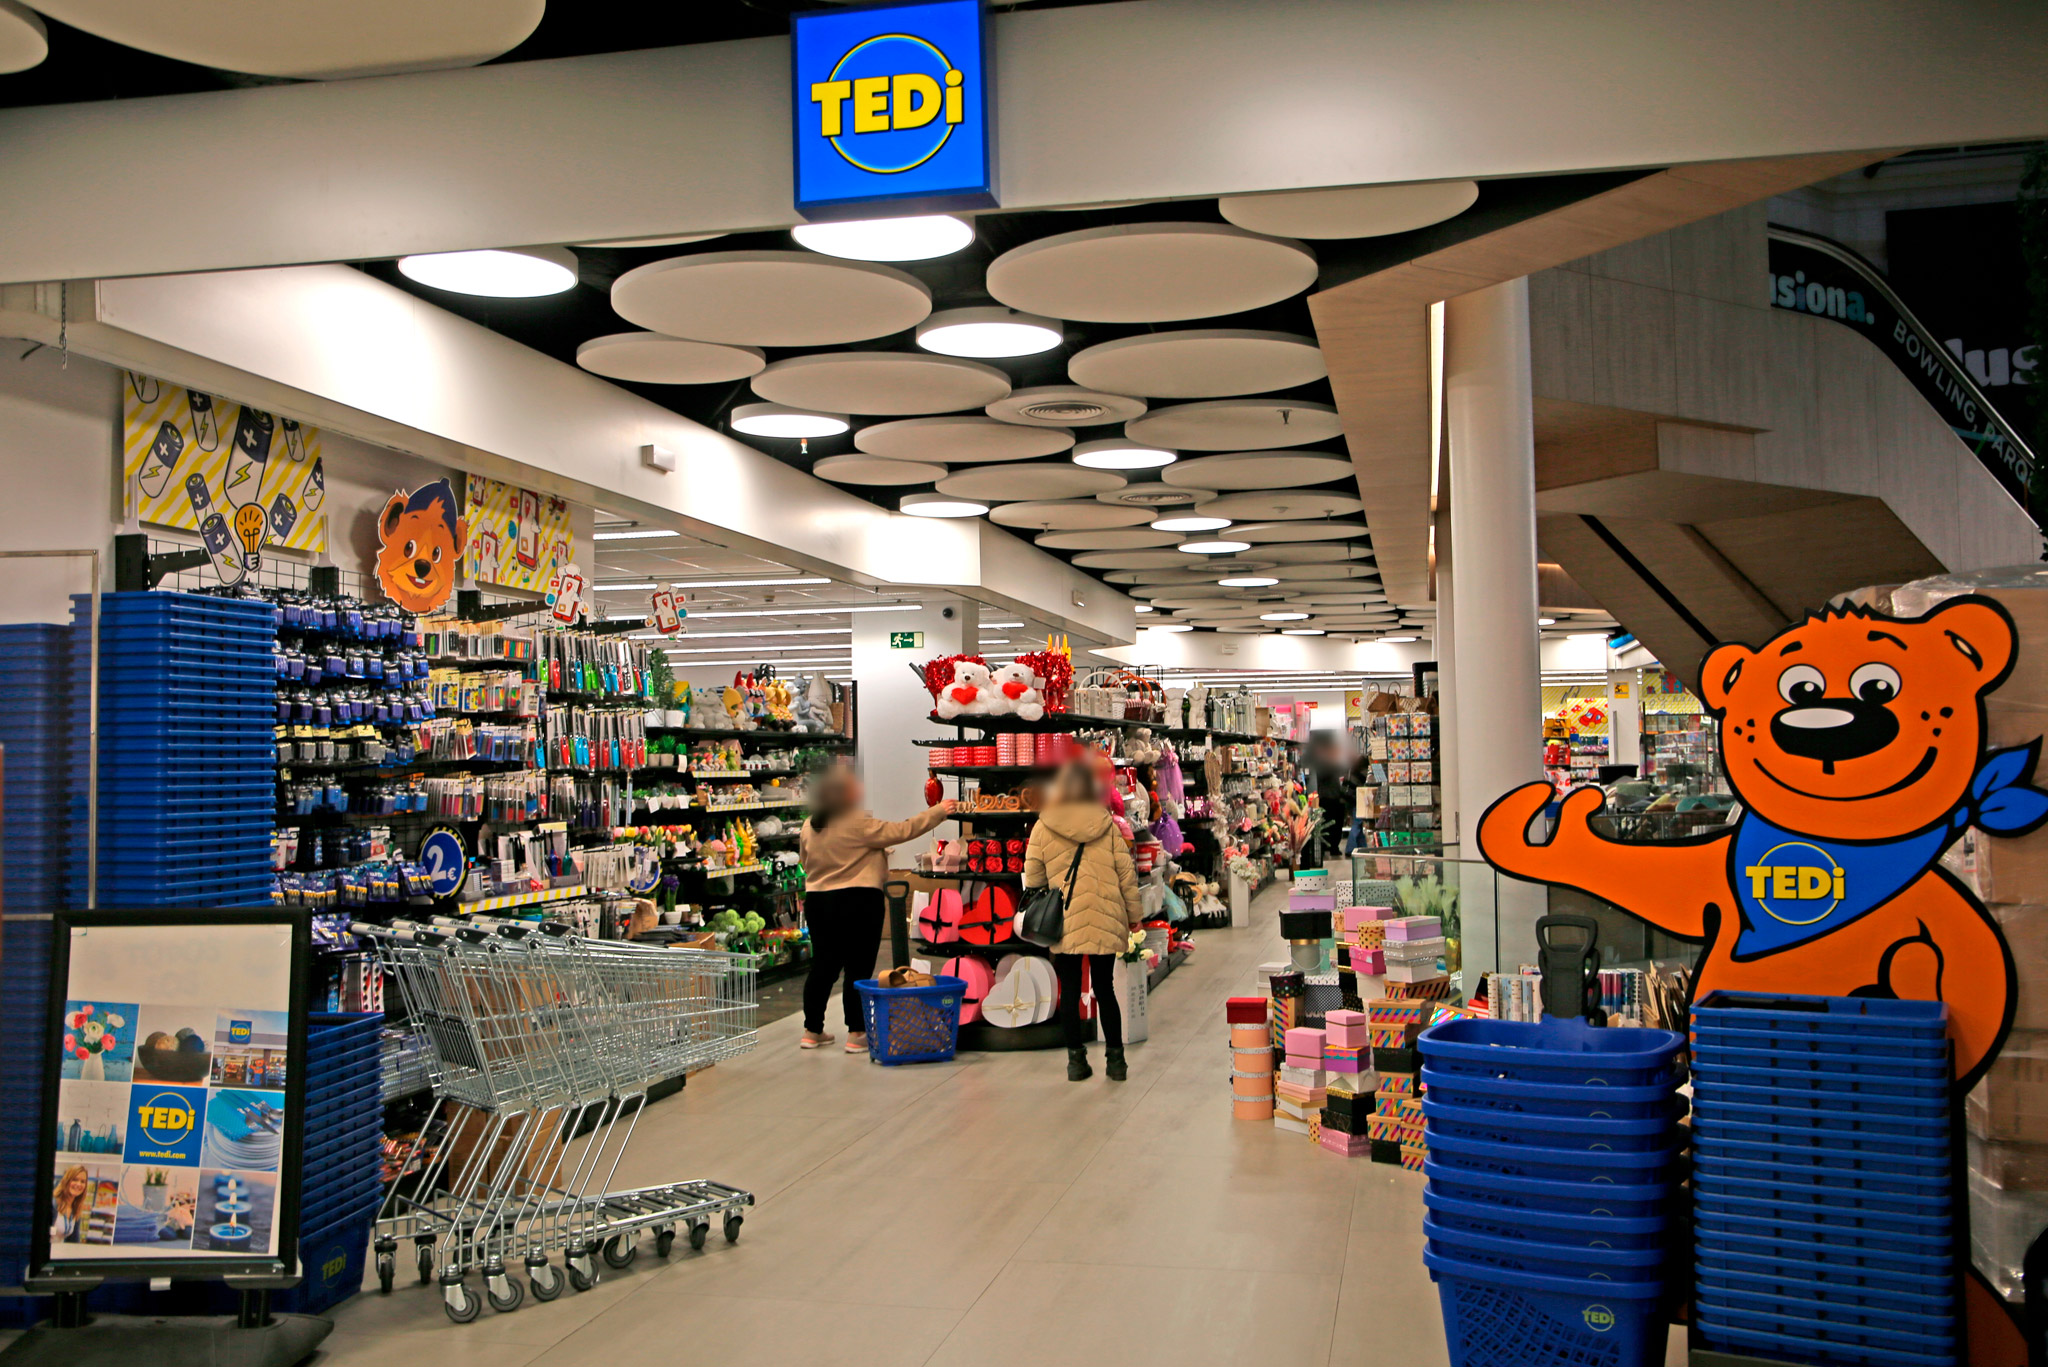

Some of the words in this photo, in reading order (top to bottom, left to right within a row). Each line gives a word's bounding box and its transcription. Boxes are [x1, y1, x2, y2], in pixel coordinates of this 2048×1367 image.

[811, 69, 964, 137] TEDi
[1893, 319, 1978, 432] BOWLING,
[1983, 421, 2036, 494] PARQ
[1745, 866, 1845, 900] TEDi
[231, 1027, 250, 1037] TEDi
[138, 1105, 196, 1132] TEDi
[139, 1149, 187, 1160] www.tedi.com
[322, 1252, 347, 1280] TEDi
[1582, 1310, 1615, 1326] TEDi
